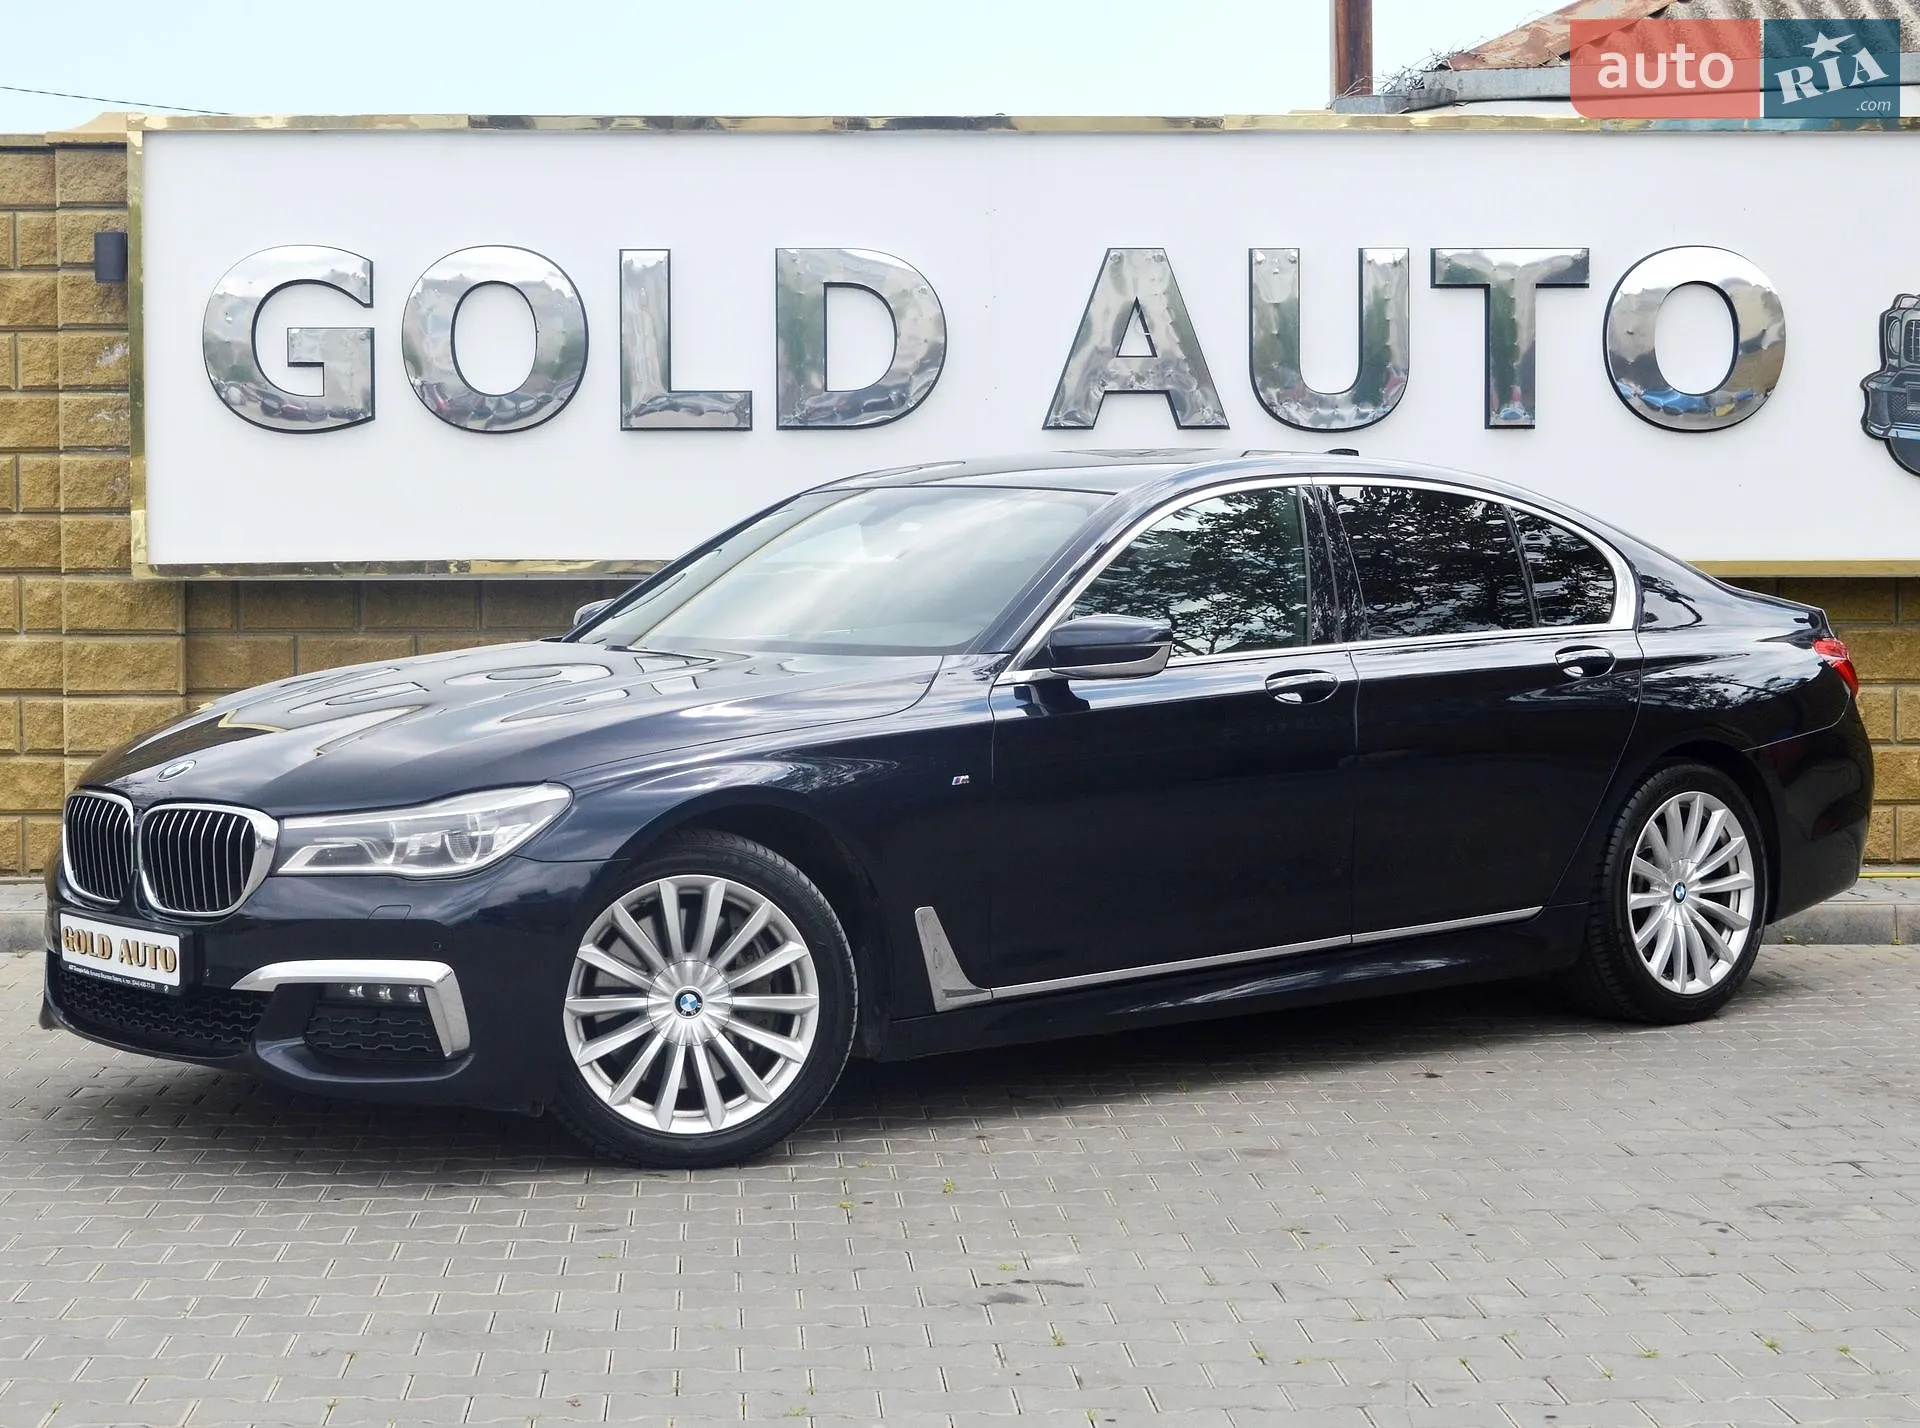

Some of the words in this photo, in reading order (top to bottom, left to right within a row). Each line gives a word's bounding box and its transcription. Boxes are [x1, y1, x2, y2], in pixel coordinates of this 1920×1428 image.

[202, 244, 948, 434] GOLD
[1041, 244, 1788, 434] AUTO
[62, 926, 112, 959] GOLD
[120, 939, 176, 972] AUTO
